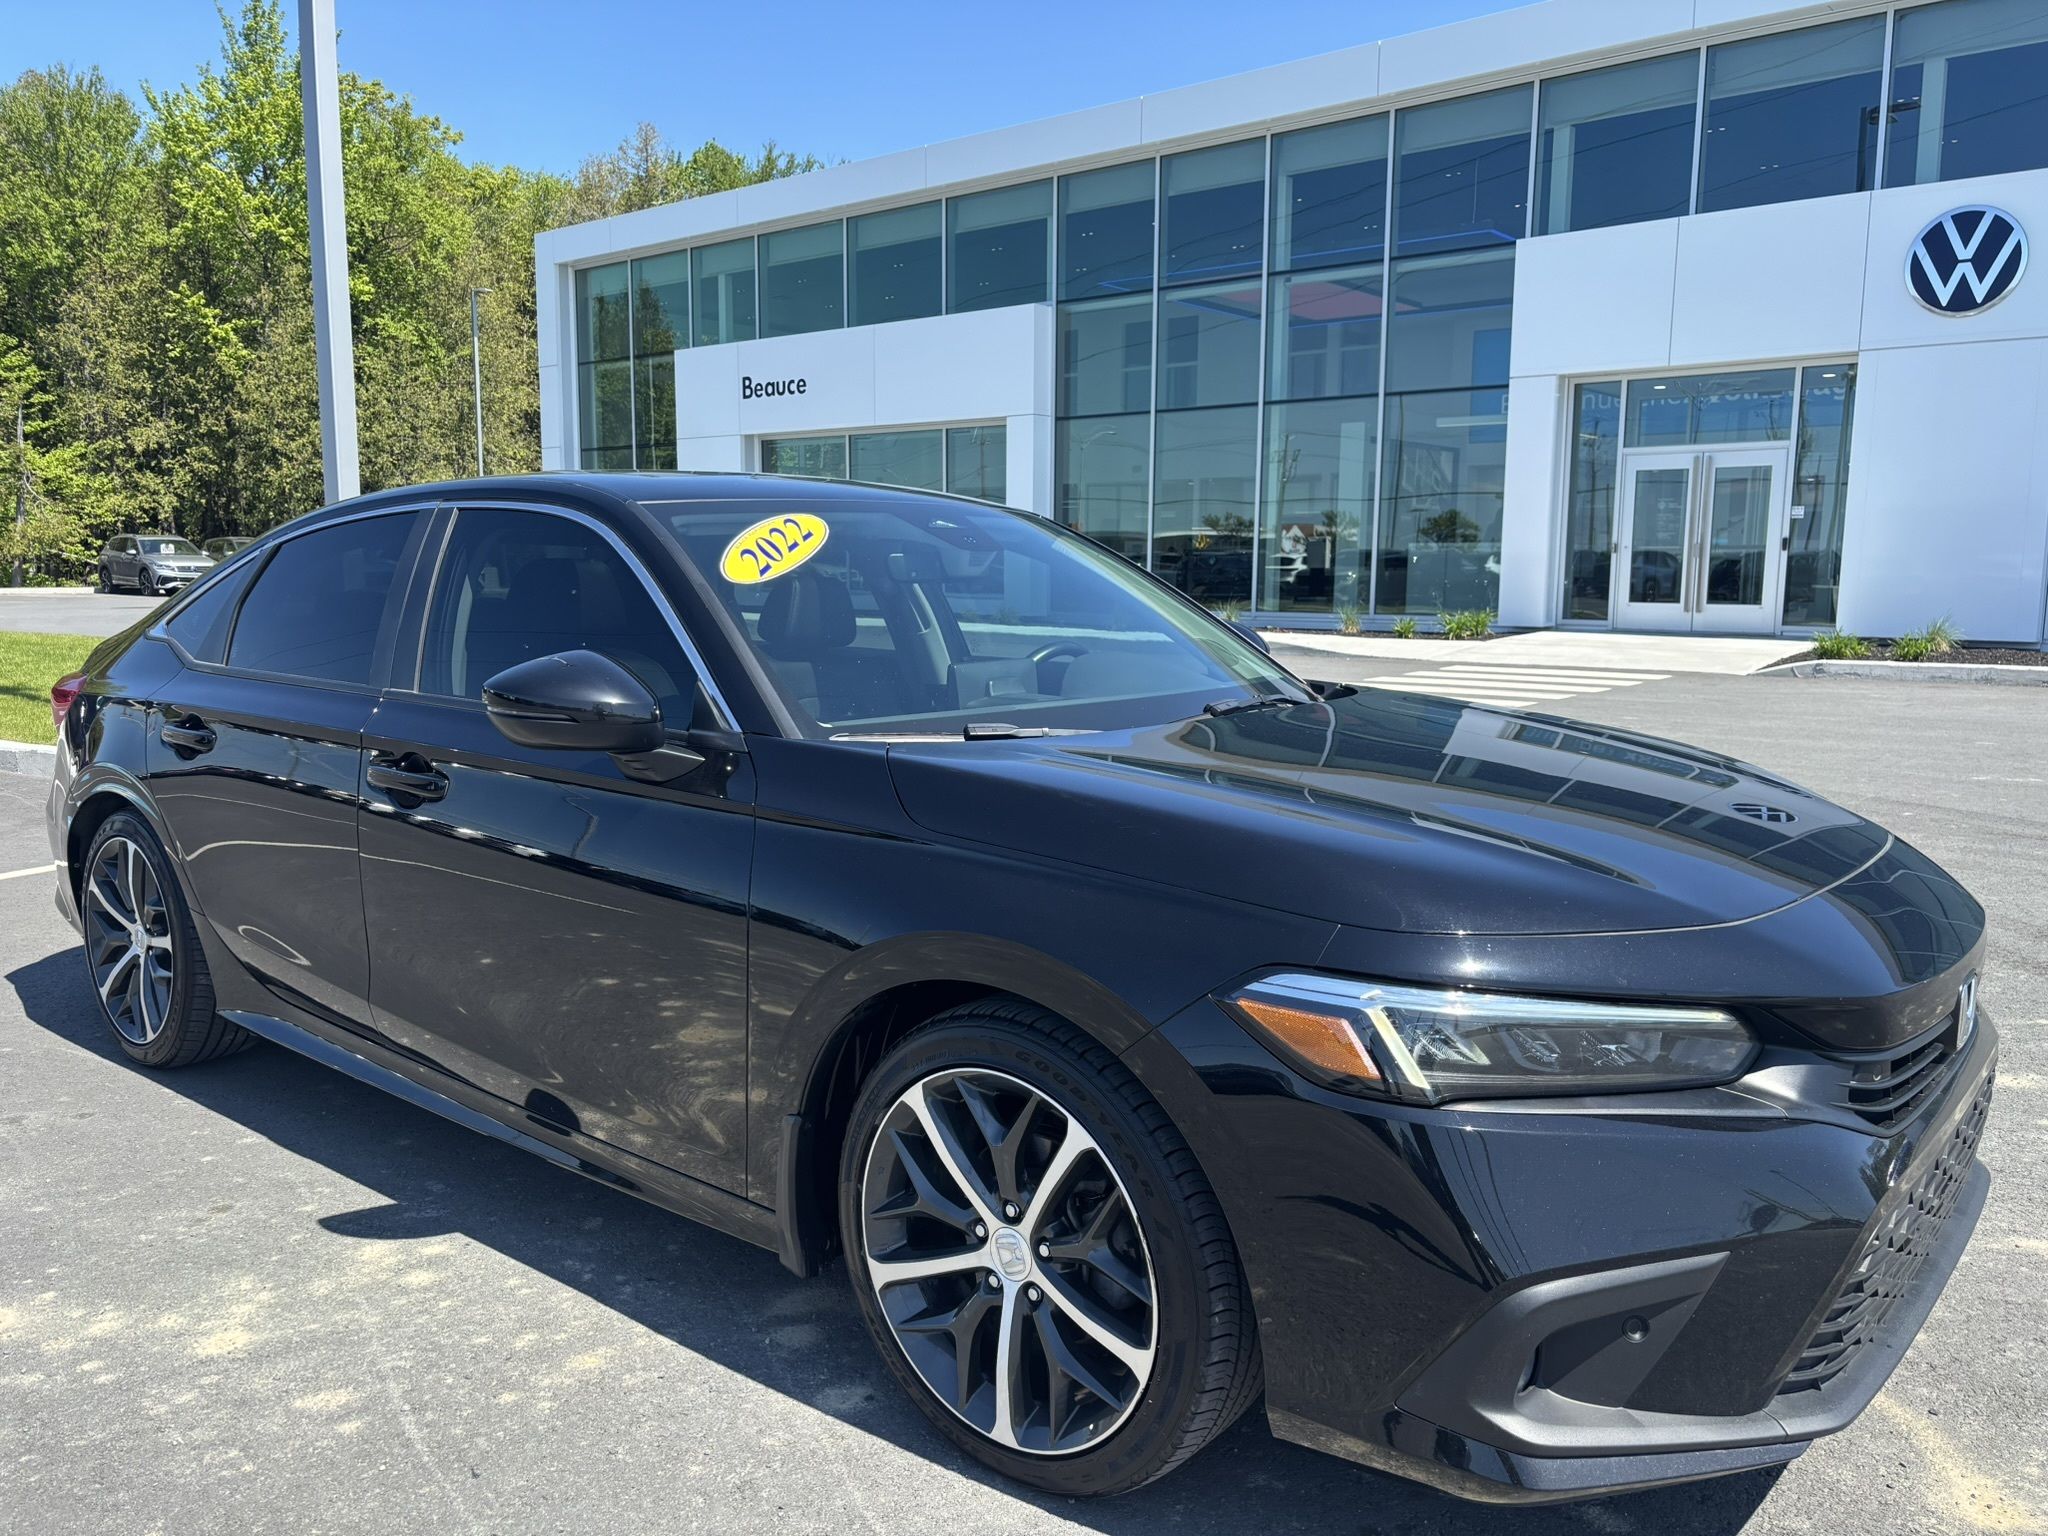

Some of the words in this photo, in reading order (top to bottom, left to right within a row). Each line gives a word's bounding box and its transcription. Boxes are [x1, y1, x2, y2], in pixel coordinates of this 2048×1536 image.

[1911, 207, 2023, 308] VW
[742, 376, 807, 400] Beauce
[740, 518, 814, 577] 2022
